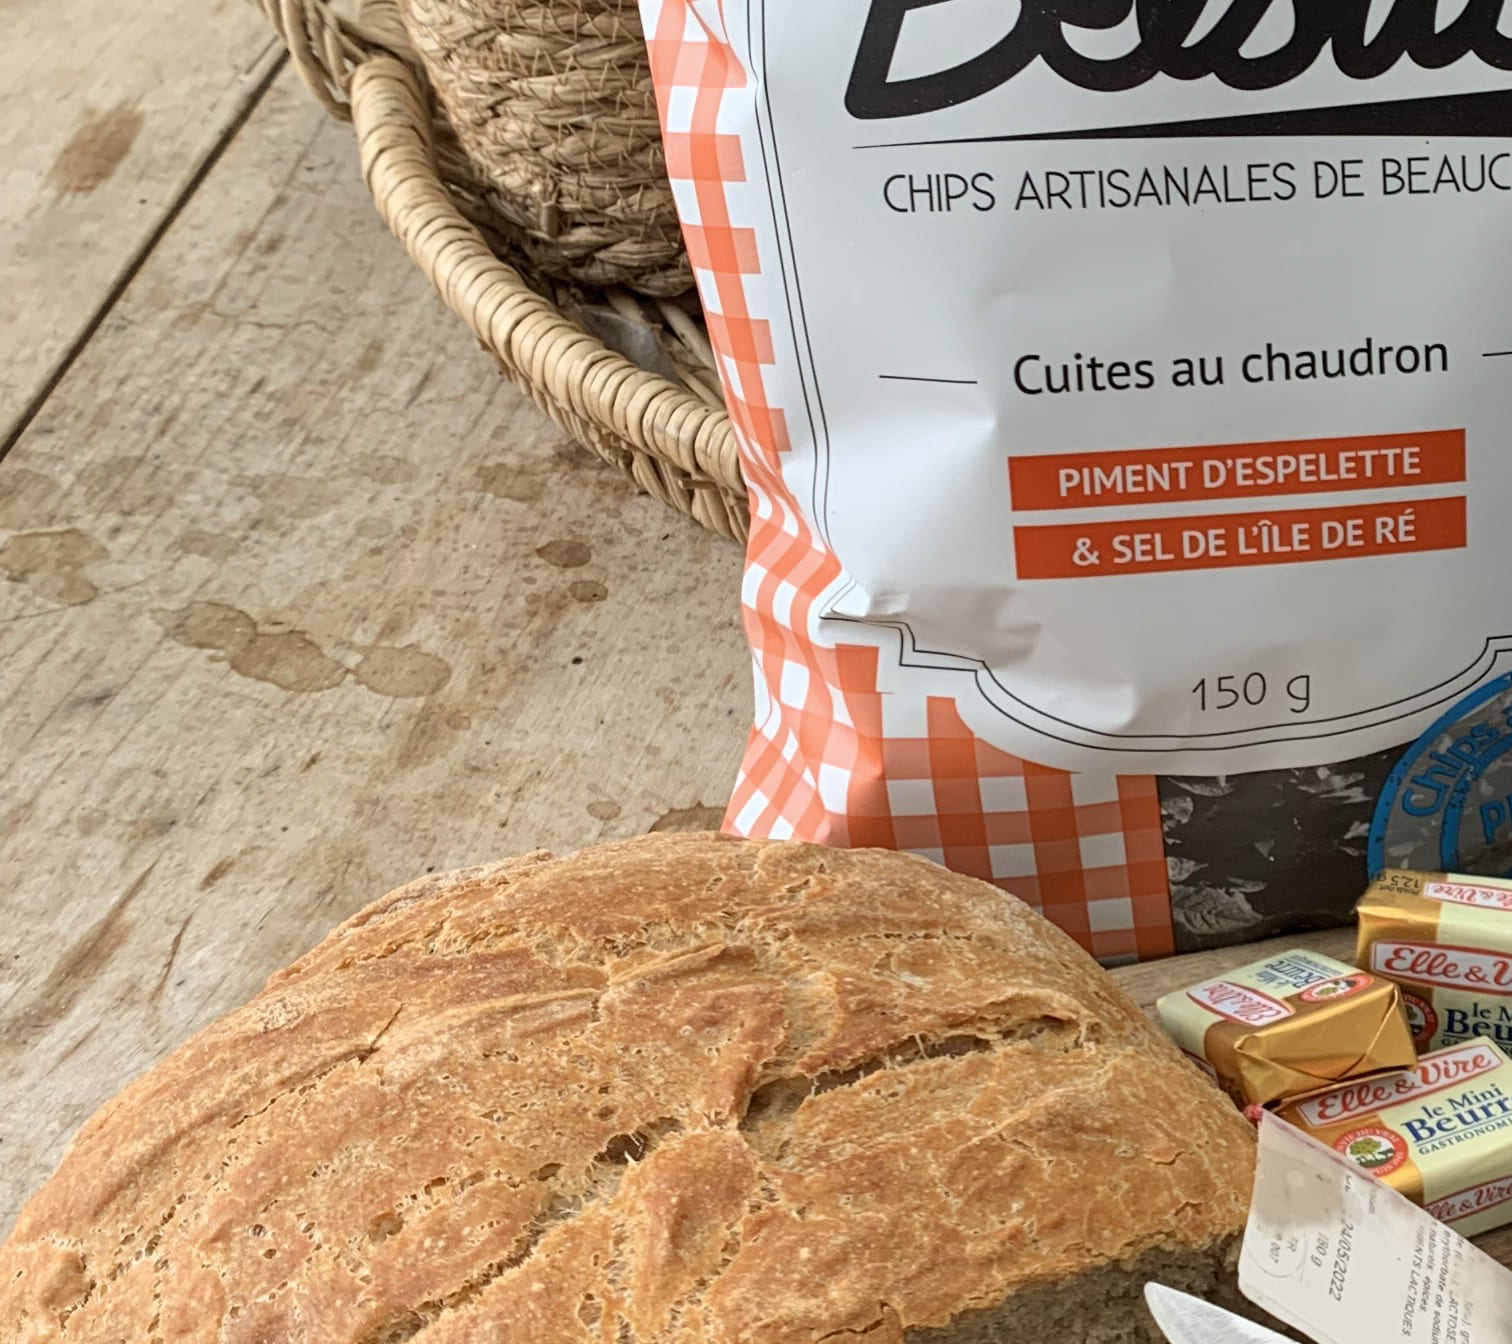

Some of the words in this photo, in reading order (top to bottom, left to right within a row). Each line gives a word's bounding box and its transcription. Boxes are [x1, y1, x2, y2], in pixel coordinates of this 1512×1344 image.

[883, 172, 996, 214] CHIPS
[1013, 162, 1297, 211] ARTISANALES
[1314, 159, 1365, 200] DE
[1013, 353, 1155, 396] Cuites
[1171, 354, 1225, 387] au
[1240, 337, 1449, 383] chaudron
[1058, 461, 1194, 497] PIMENT
[1202, 446, 1422, 489] D'ESPELETTE
[1072, 537, 1101, 567] &
[1111, 532, 1175, 564] SEL
[1181, 528, 1227, 559] DE
[1237, 519, 1311, 555] L'ÎLE
[1320, 518, 1366, 549] DE
[1374, 508, 1418, 544] RÉ
[1191, 671, 1268, 713] 150
[1285, 673, 1312, 714] g
[1402, 719, 1499, 817] Chips
[1431, 884, 1478, 904] Vire
[1384, 946, 1461, 980] Elle
[1464, 964, 1490, 986] &
[1472, 1002, 1492, 1019] le
[1317, 1085, 1392, 1121] Elle
[1394, 1078, 1422, 1095] &
[1414, 1052, 1493, 1086] Vire
[1421, 1103, 1445, 1119] le
[1448, 1082, 1504, 1110] Mini
[1328, 1217, 1355, 1302] 24/05/2022
